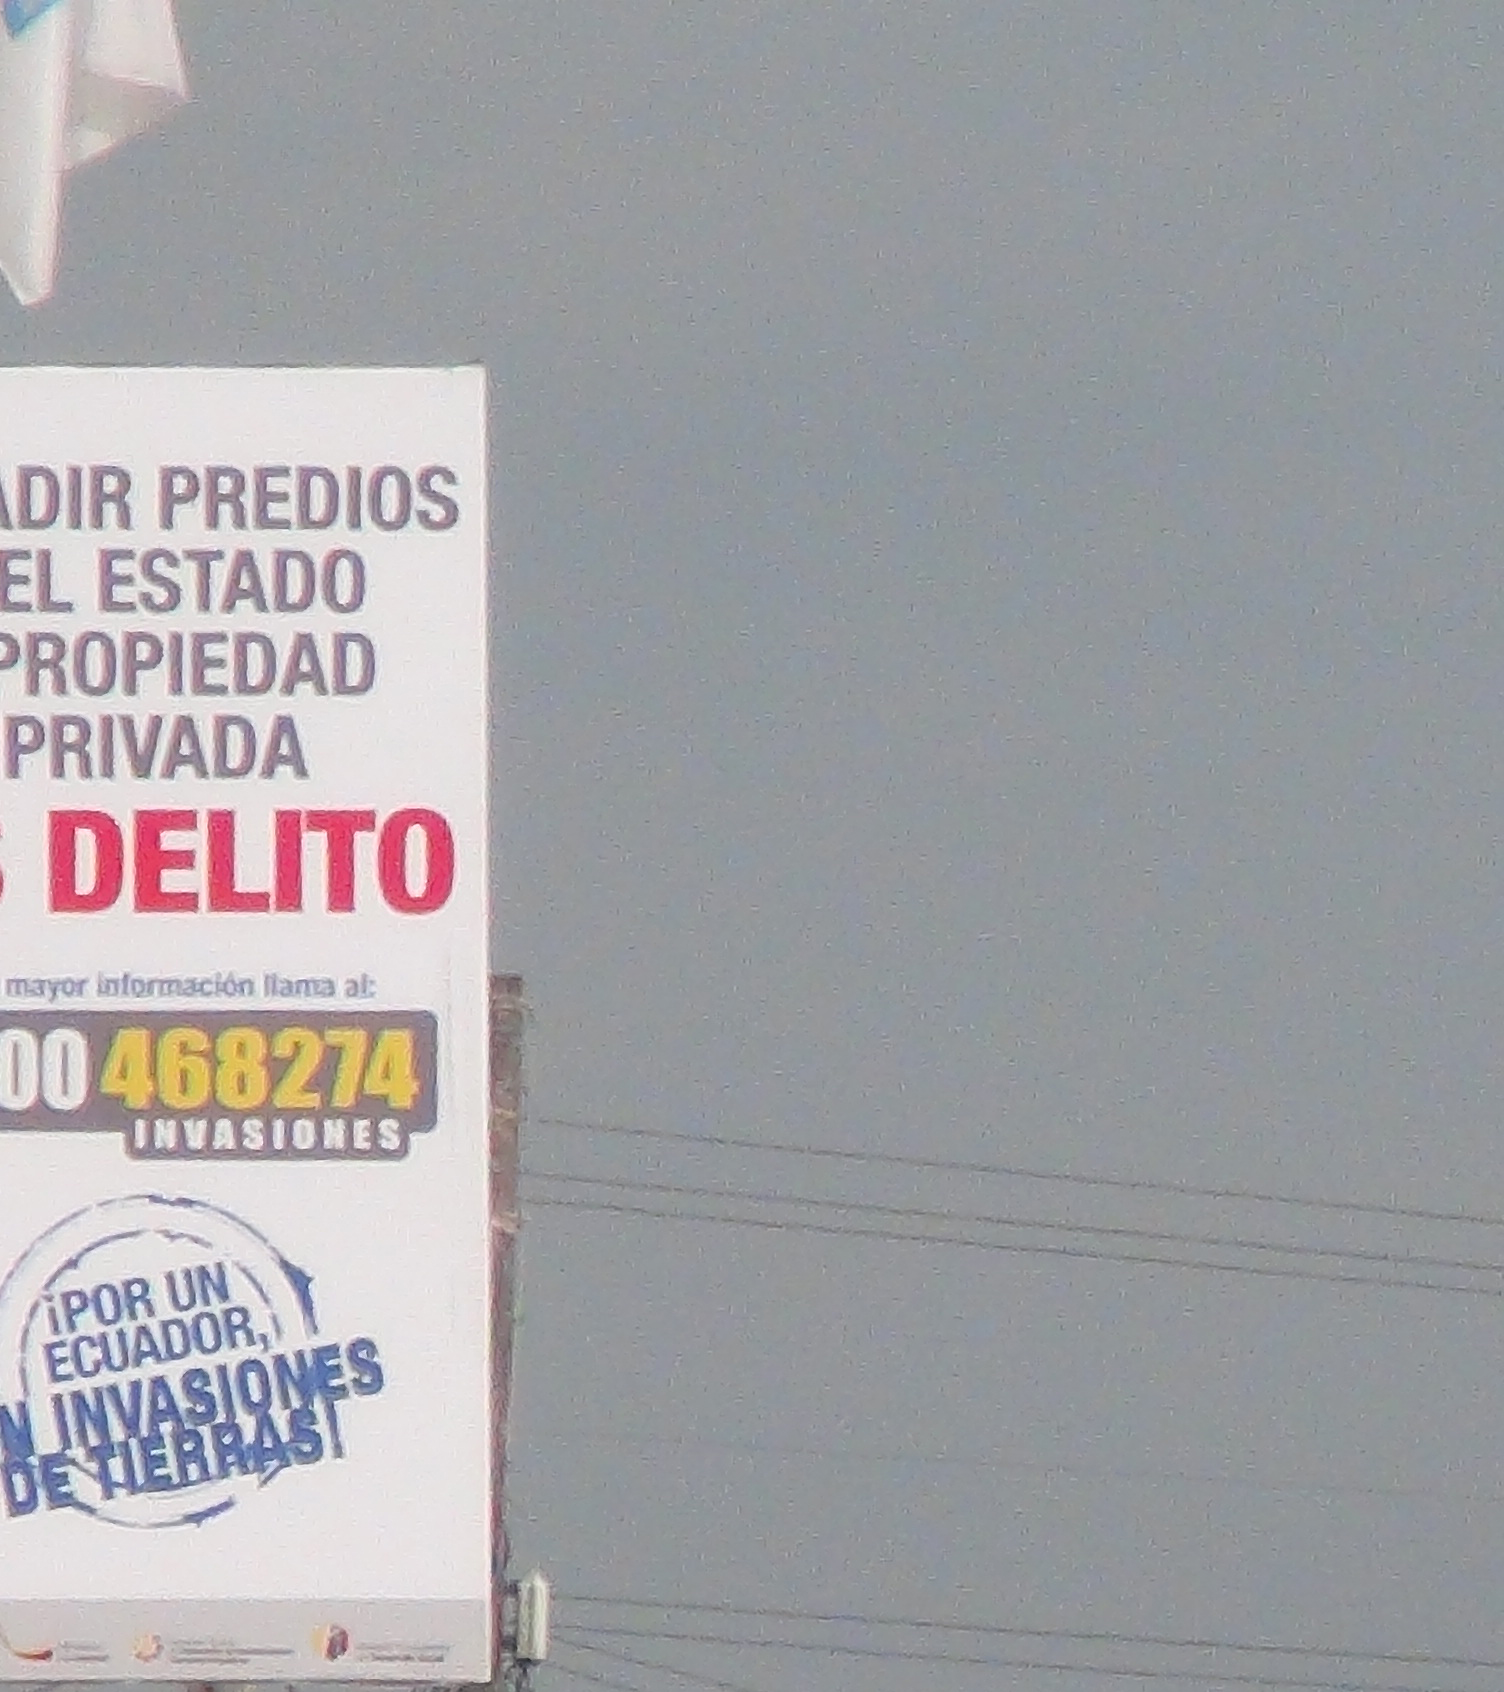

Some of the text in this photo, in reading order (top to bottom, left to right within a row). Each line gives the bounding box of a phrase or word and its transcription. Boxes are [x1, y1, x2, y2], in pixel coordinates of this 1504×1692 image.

[157, 464, 461, 532] PREDIOS
[97, 547, 366, 614] ESTADO
[3, 713, 310, 779] PRIVADA
[46, 807, 457, 915] DELITO
[6, 976, 87, 1003] mayor
[97, 972, 255, 999] información
[263, 972, 336, 998] llama
[99, 1026, 420, 1112] 468274
[133, 1118, 403, 1151] INVASIONES
[46, 1260, 232, 1336] ¡POR UN
[43, 1305, 270, 1385] ECUADOR,
[49, 1336, 386, 1463] INVASIONES
[0, 1401, 347, 1519] DE TIERRAS!
